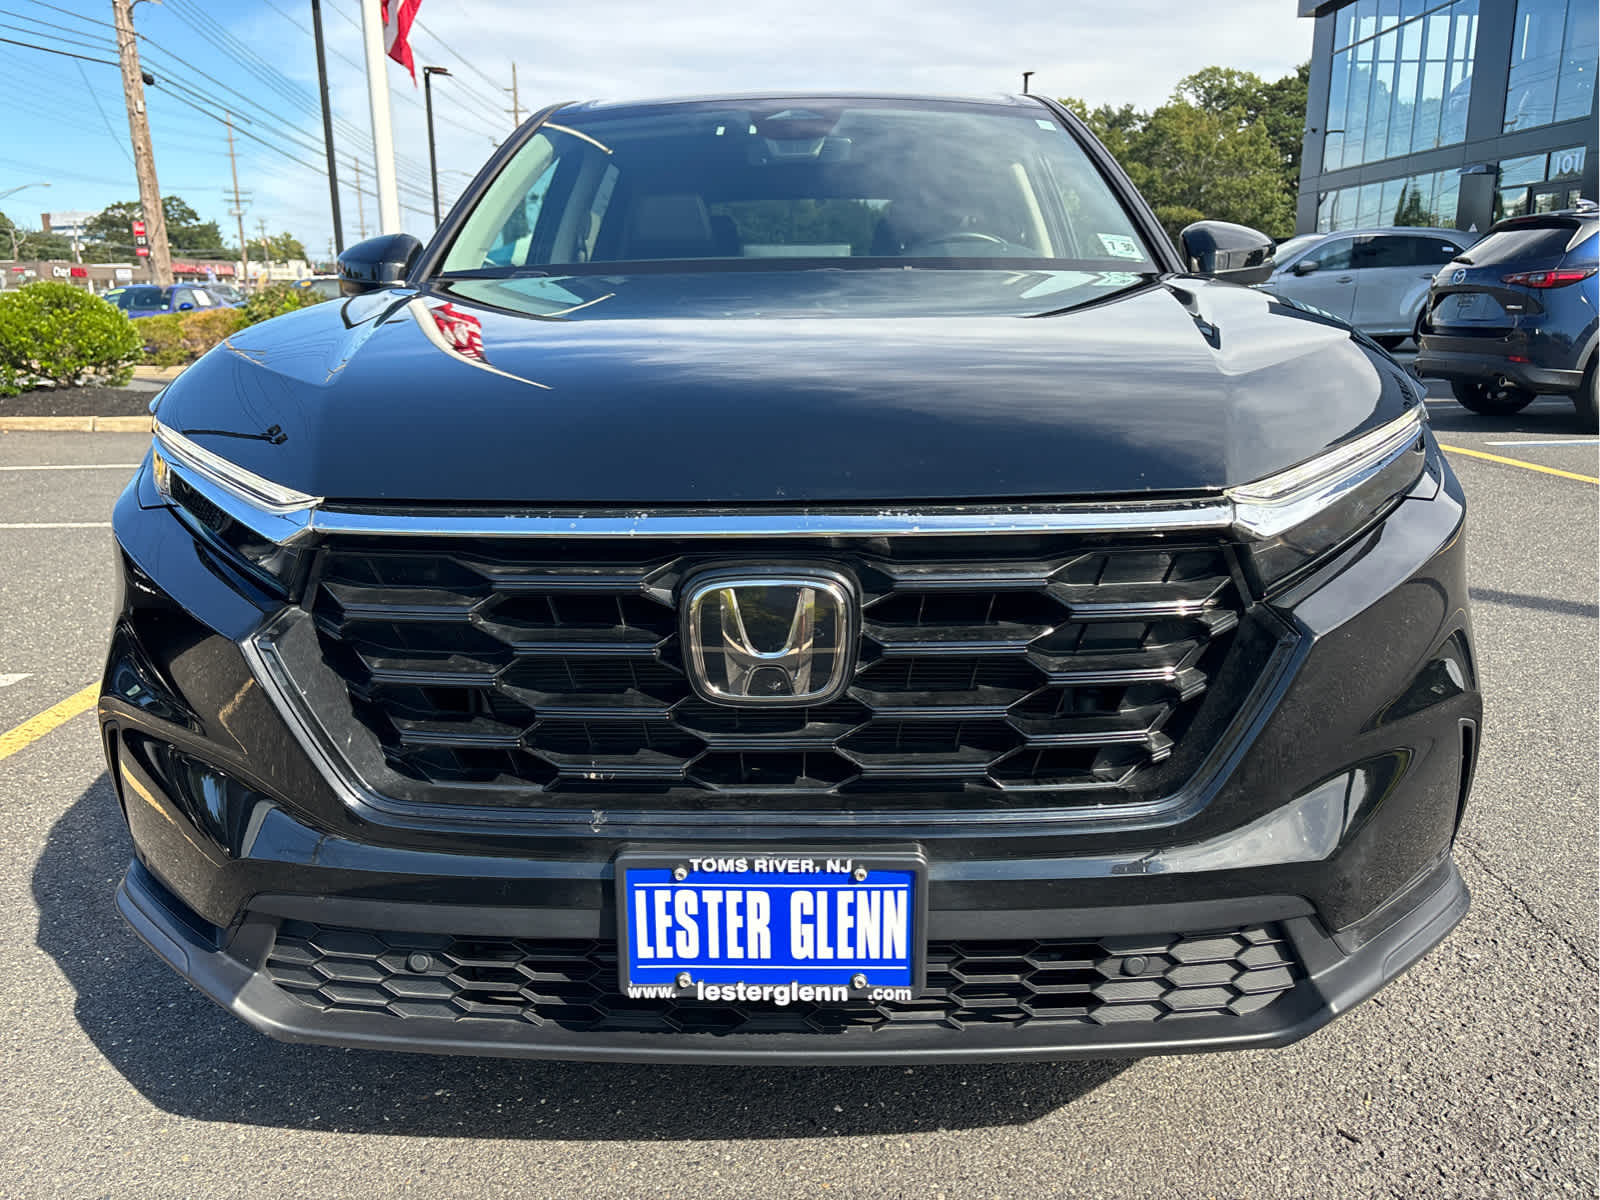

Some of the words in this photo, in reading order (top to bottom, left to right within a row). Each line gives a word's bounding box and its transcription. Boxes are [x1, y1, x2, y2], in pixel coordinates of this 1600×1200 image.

[689, 858, 749, 873] TOMS
[754, 858, 820, 874] RIVER,
[827, 859, 852, 873] NJ
[635, 889, 771, 959] LESTER
[790, 890, 907, 960] GLENN
[627, 986, 676, 999] www.
[697, 981, 848, 1006] lesterglenn
[868, 987, 912, 1001] .com
